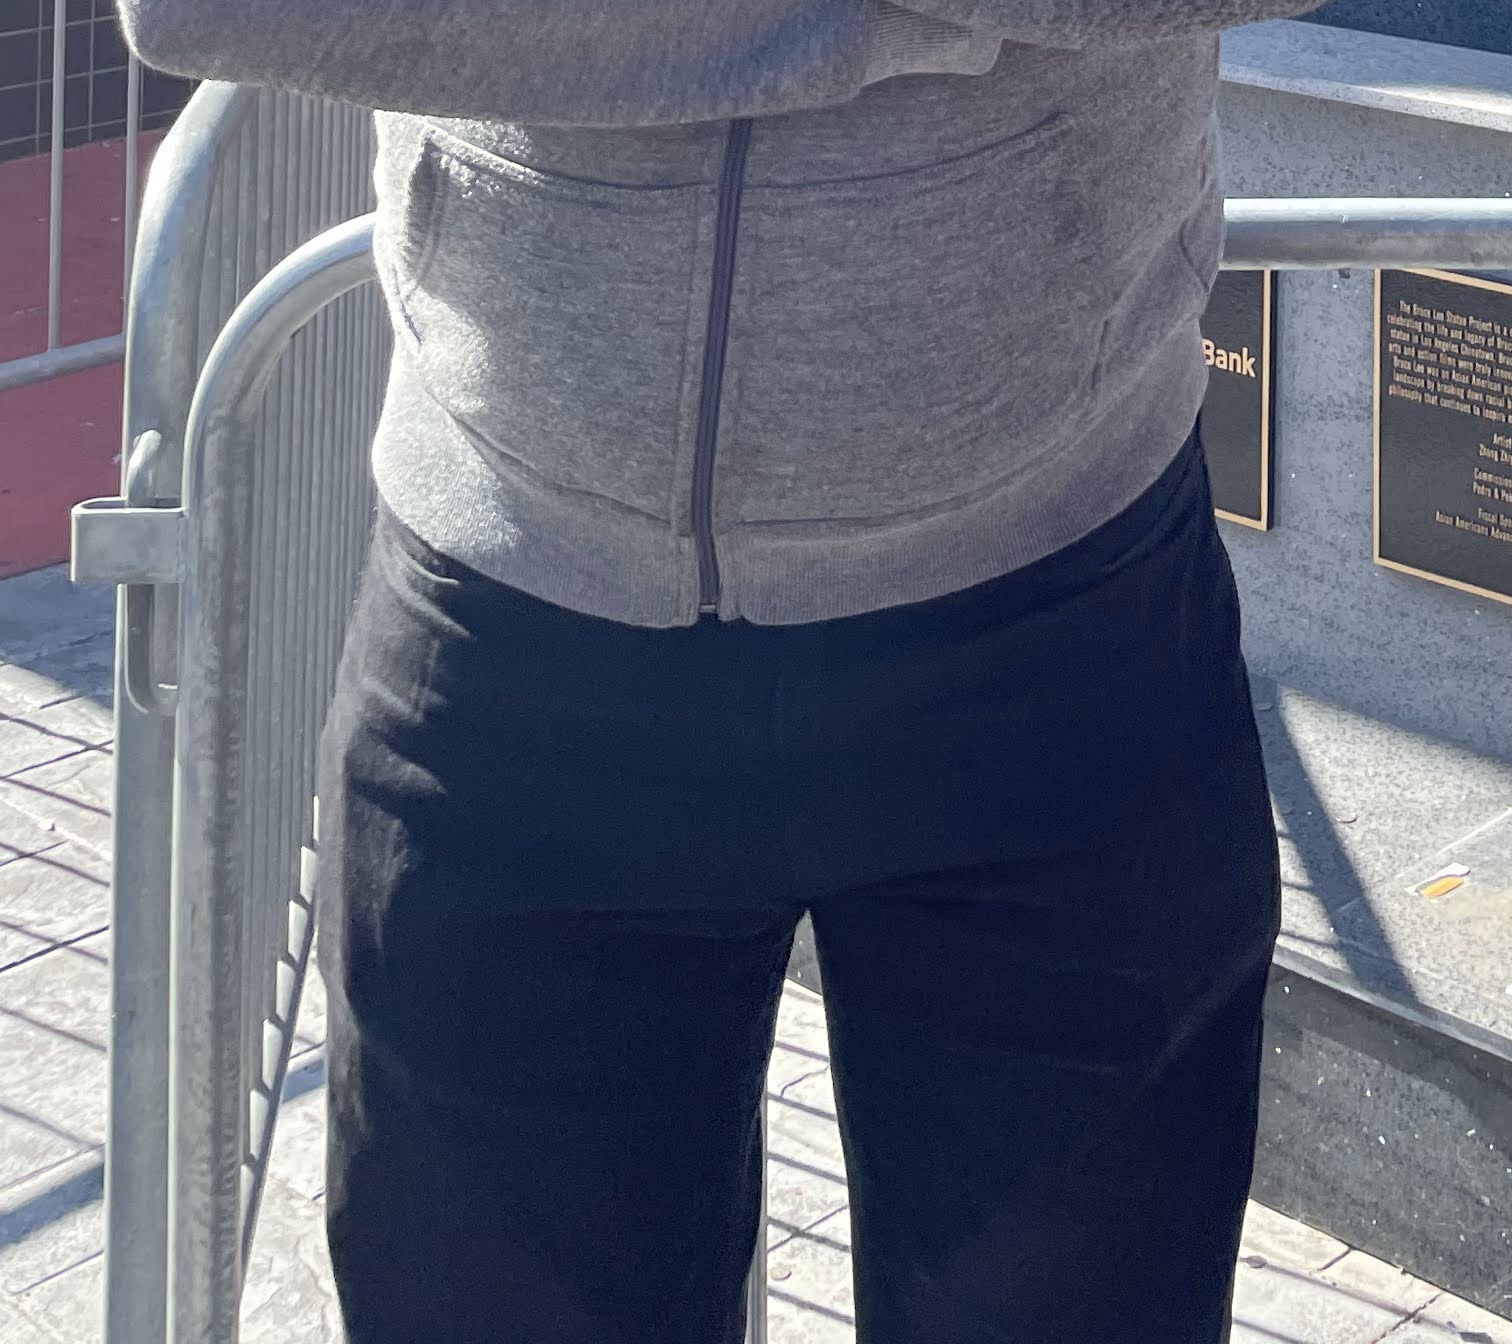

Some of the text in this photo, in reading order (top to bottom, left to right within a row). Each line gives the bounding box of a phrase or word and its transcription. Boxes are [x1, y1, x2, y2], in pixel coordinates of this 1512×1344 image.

[1399, 300, 1411, 315] The
[1412, 303, 1431, 319] Bruce
[1432, 308, 1445, 323] Lee
[1446, 310, 1467, 327] Statue
[1468, 315, 1493, 333] Project
[1434, 337, 1459, 354] Angeles
[1202, 339, 1256, 378] Bank
[1393, 355, 1412, 371] Bruce
[1412, 360, 1425, 375] Lee
[1492, 433, 1512, 450] Artist
[1435, 510, 1454, 526] Asian
[1455, 516, 1489, 536] Americans
